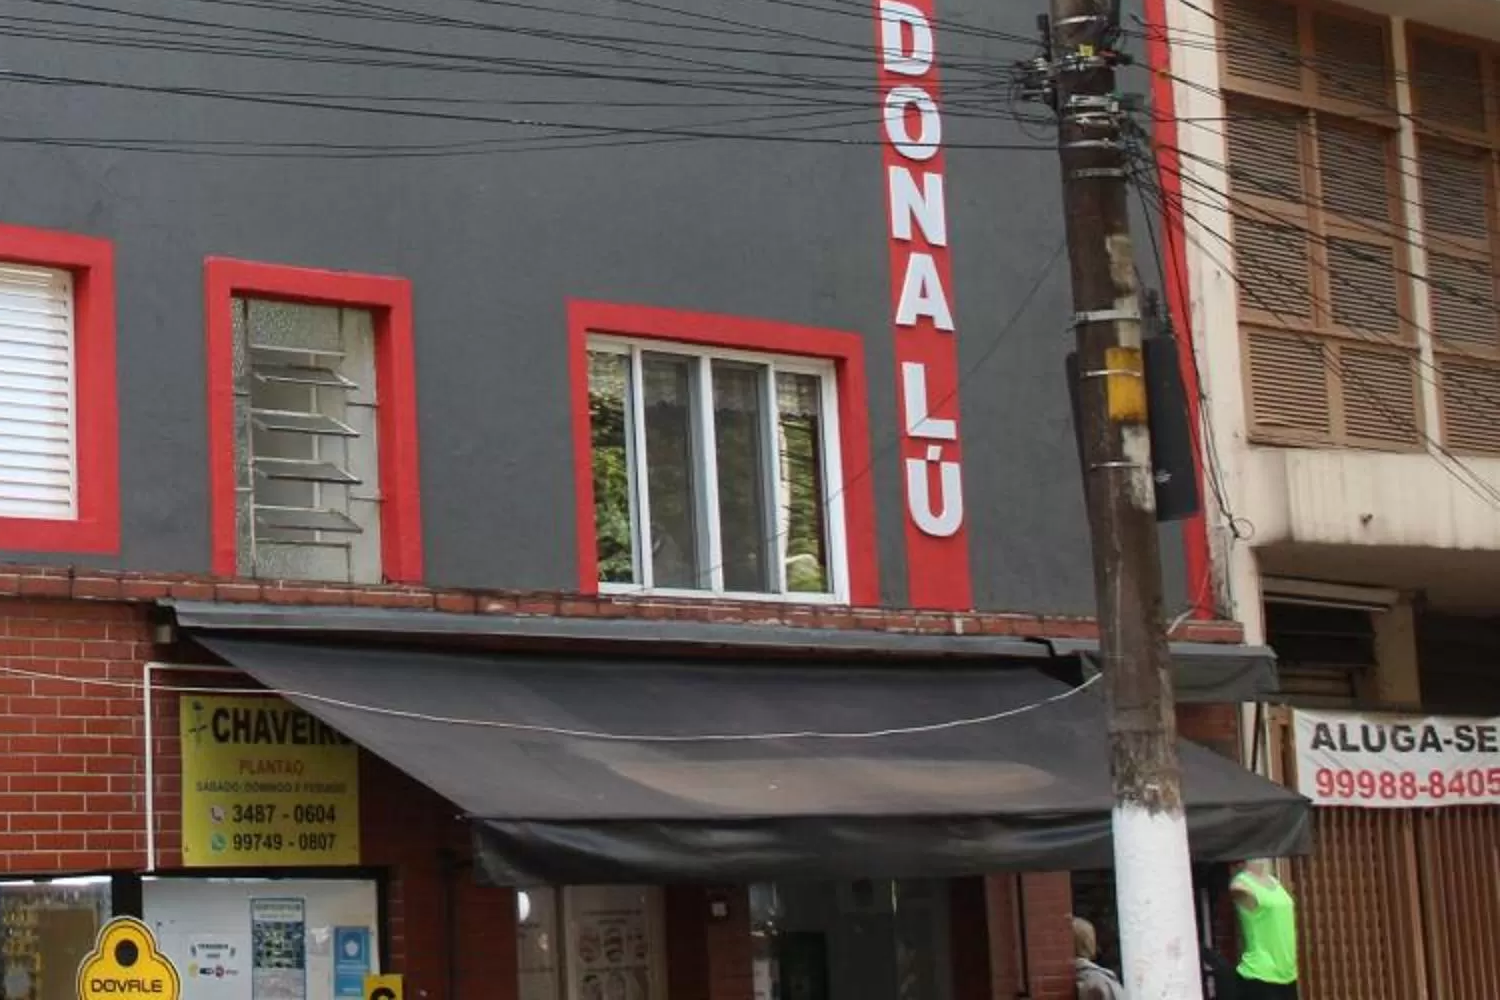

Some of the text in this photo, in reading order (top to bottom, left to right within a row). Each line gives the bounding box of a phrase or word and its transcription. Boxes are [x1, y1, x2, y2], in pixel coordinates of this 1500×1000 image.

[902, 362, 964, 537] LÚ
[212, 707, 353, 745] CHAVEIR
[1311, 722, 1499, 752] ALUGA-SE
[1316, 767, 1500, 800] 99988-8405
[232, 804, 276, 824] 3487
[293, 804, 336, 824] 0604
[233, 833, 282, 851] 99749
[91, 979, 164, 993] DOVALE
